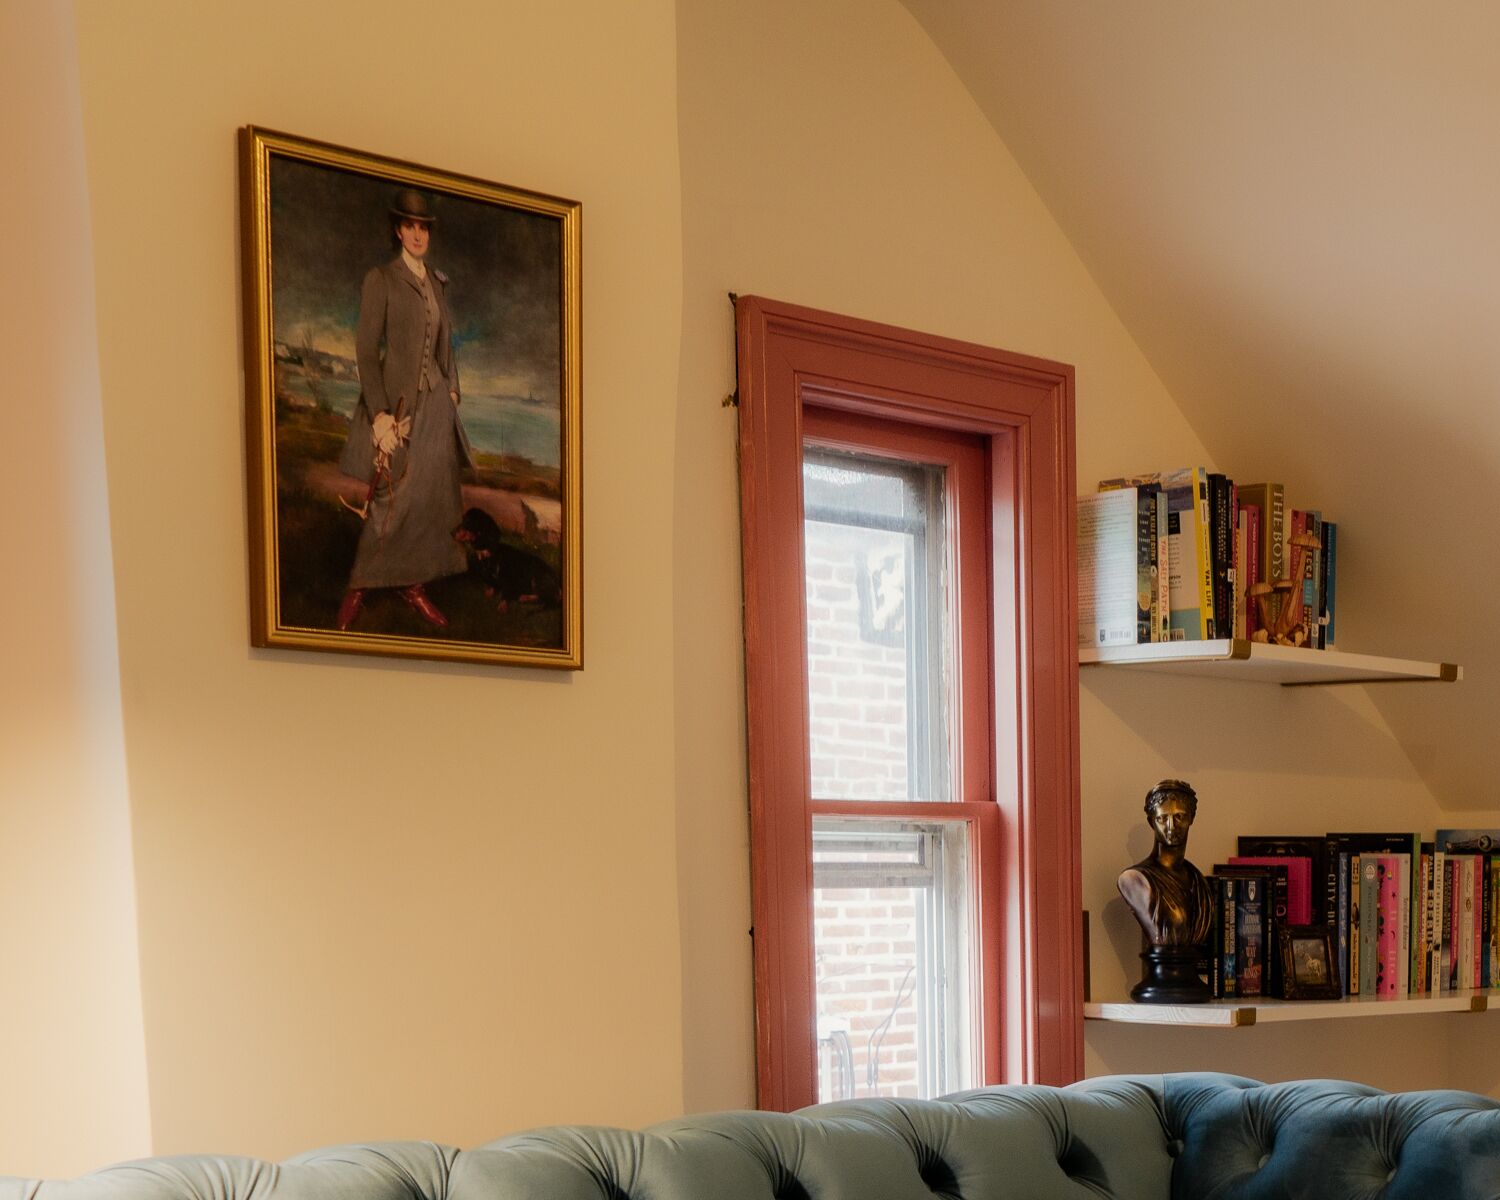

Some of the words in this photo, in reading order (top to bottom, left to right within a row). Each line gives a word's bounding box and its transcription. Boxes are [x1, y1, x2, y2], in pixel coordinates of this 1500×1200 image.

[1273, 492, 1282, 527] THE
[1272, 531, 1281, 577] BOYS
[1160, 585, 1168, 612] PATH
[1246, 946, 1257, 957] WAY
[1244, 967, 1258, 978] KINGS
